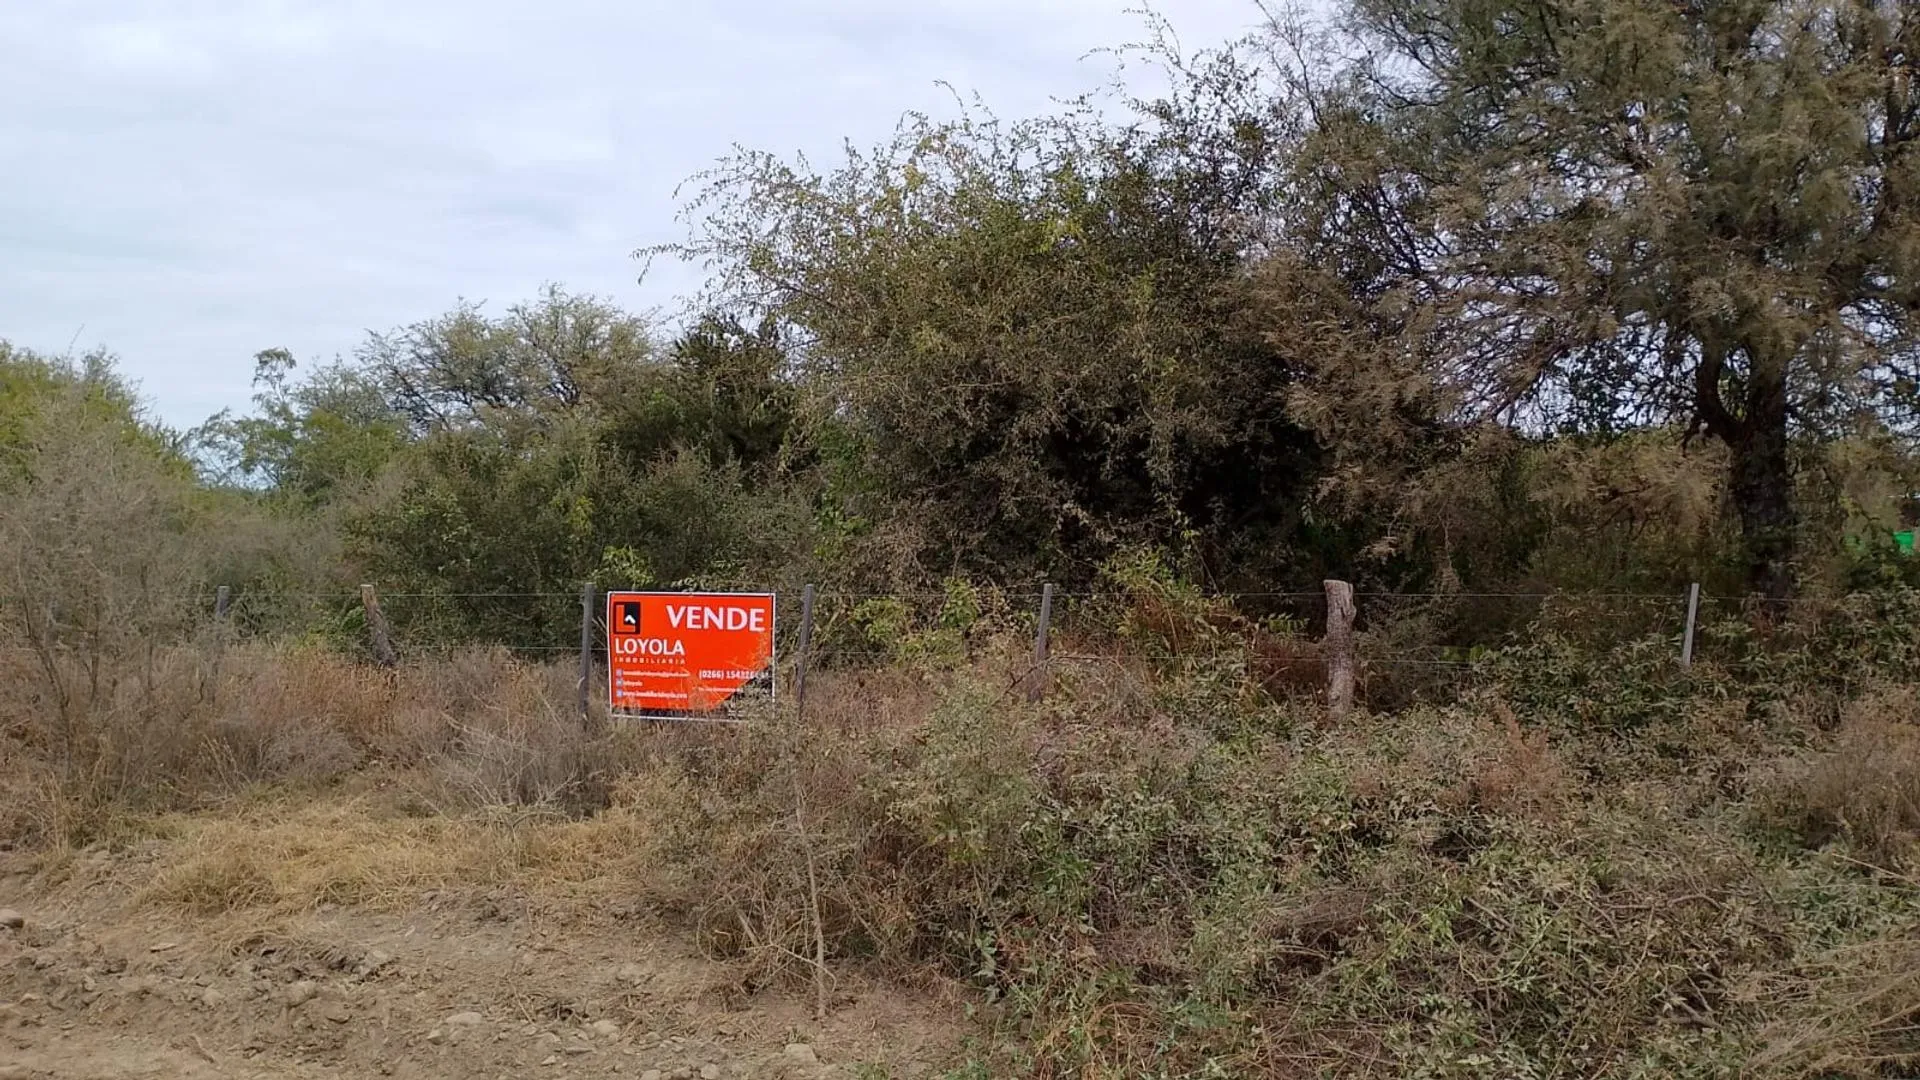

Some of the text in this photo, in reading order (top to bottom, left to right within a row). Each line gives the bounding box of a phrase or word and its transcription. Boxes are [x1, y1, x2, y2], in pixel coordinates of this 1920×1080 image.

[666, 605, 765, 631] VENDE
[615, 638, 685, 655] LOYOLA
[614, 657, 685, 665] INMOBILIARIA
